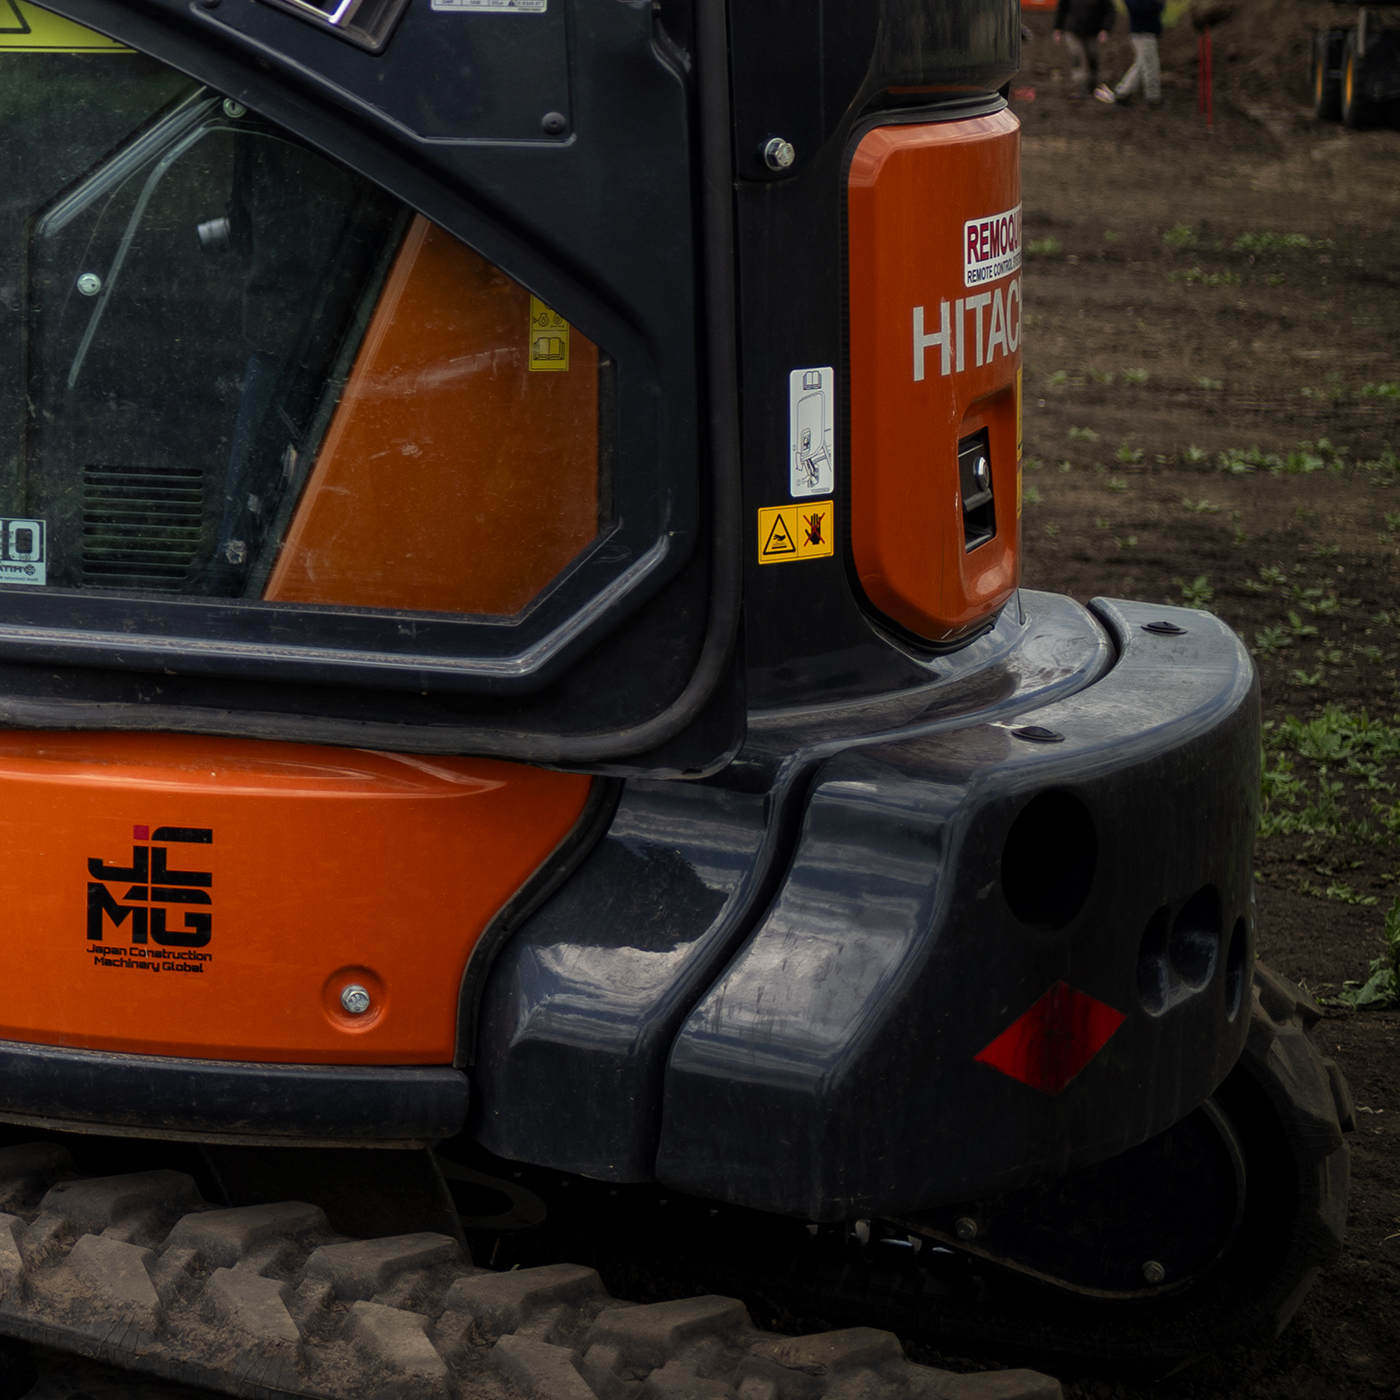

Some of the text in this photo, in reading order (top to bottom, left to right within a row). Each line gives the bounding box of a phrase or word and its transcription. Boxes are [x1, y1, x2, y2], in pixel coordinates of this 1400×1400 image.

[967, 265, 993, 284] REMOTE
[86, 943, 212, 962] Japan Construction
[94, 956, 204, 974] Machinery Global
